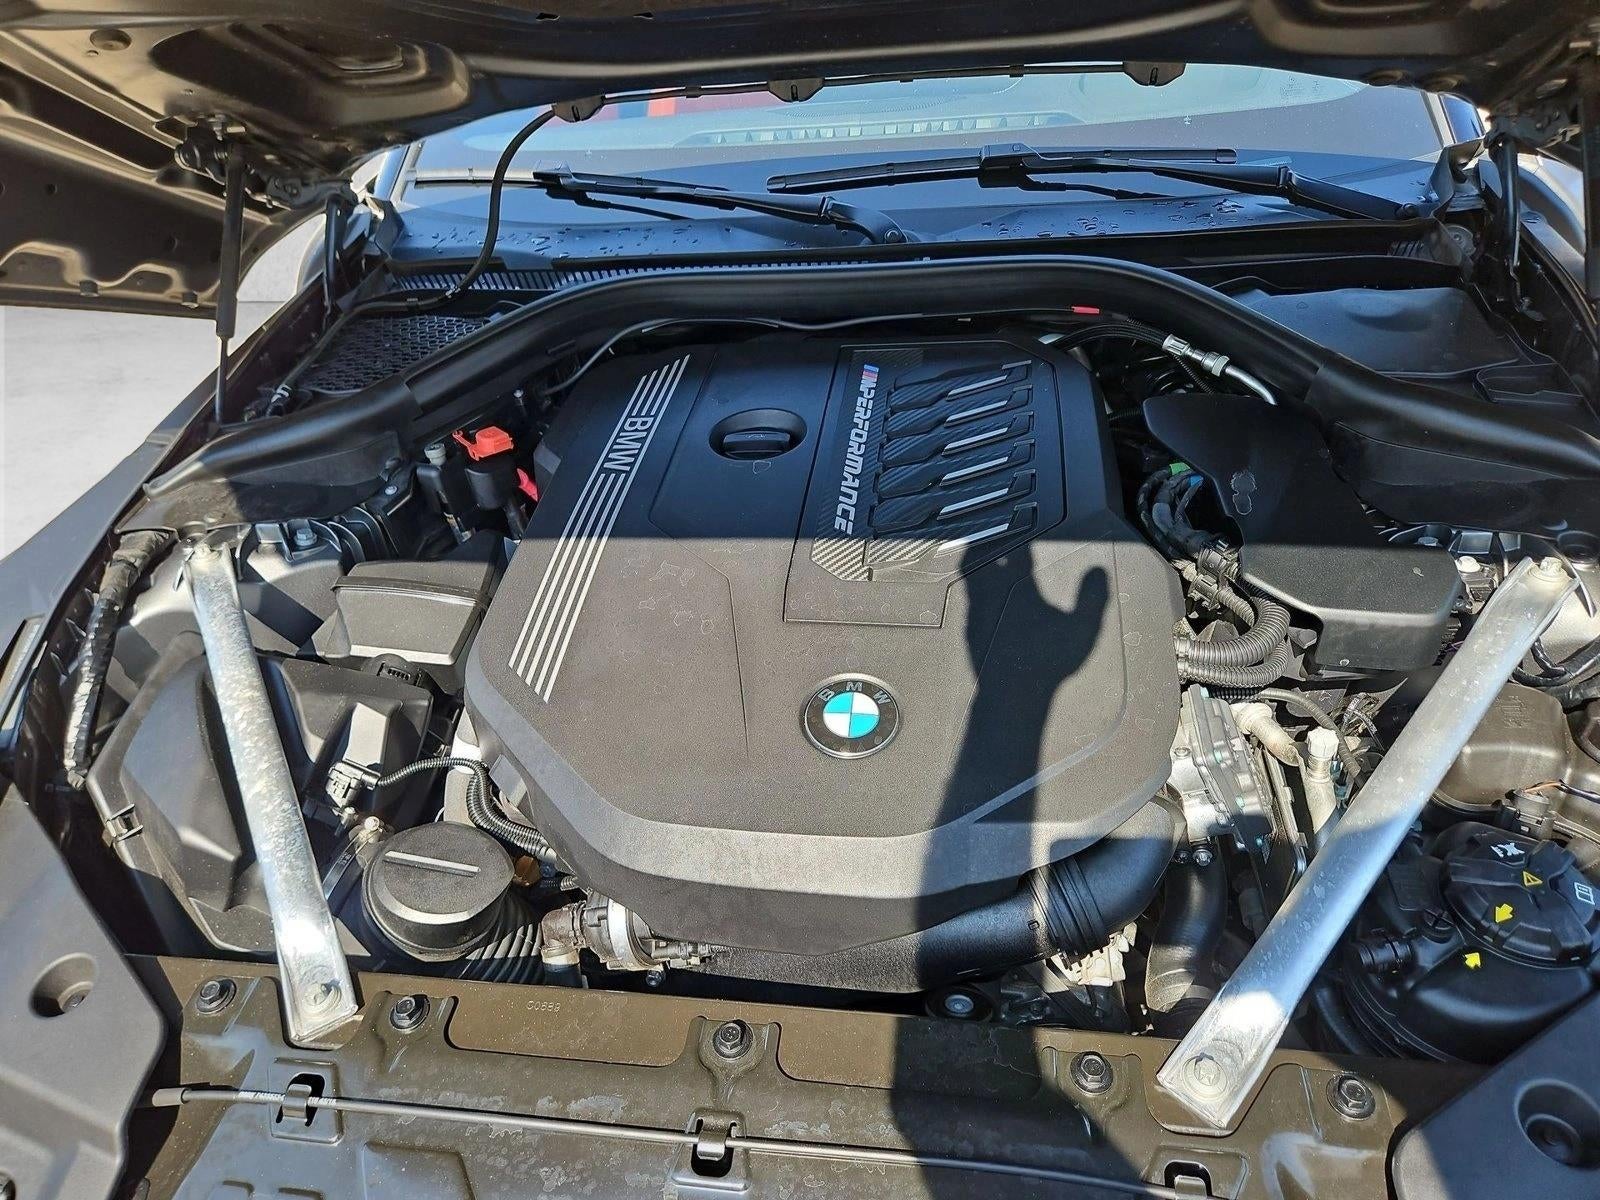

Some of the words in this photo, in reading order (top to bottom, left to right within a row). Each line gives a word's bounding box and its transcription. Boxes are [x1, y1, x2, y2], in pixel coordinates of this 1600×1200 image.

[603, 416, 655, 472] BMW
[834, 383, 876, 535] PERFORMANCE
[817, 681, 891, 705] BMW
